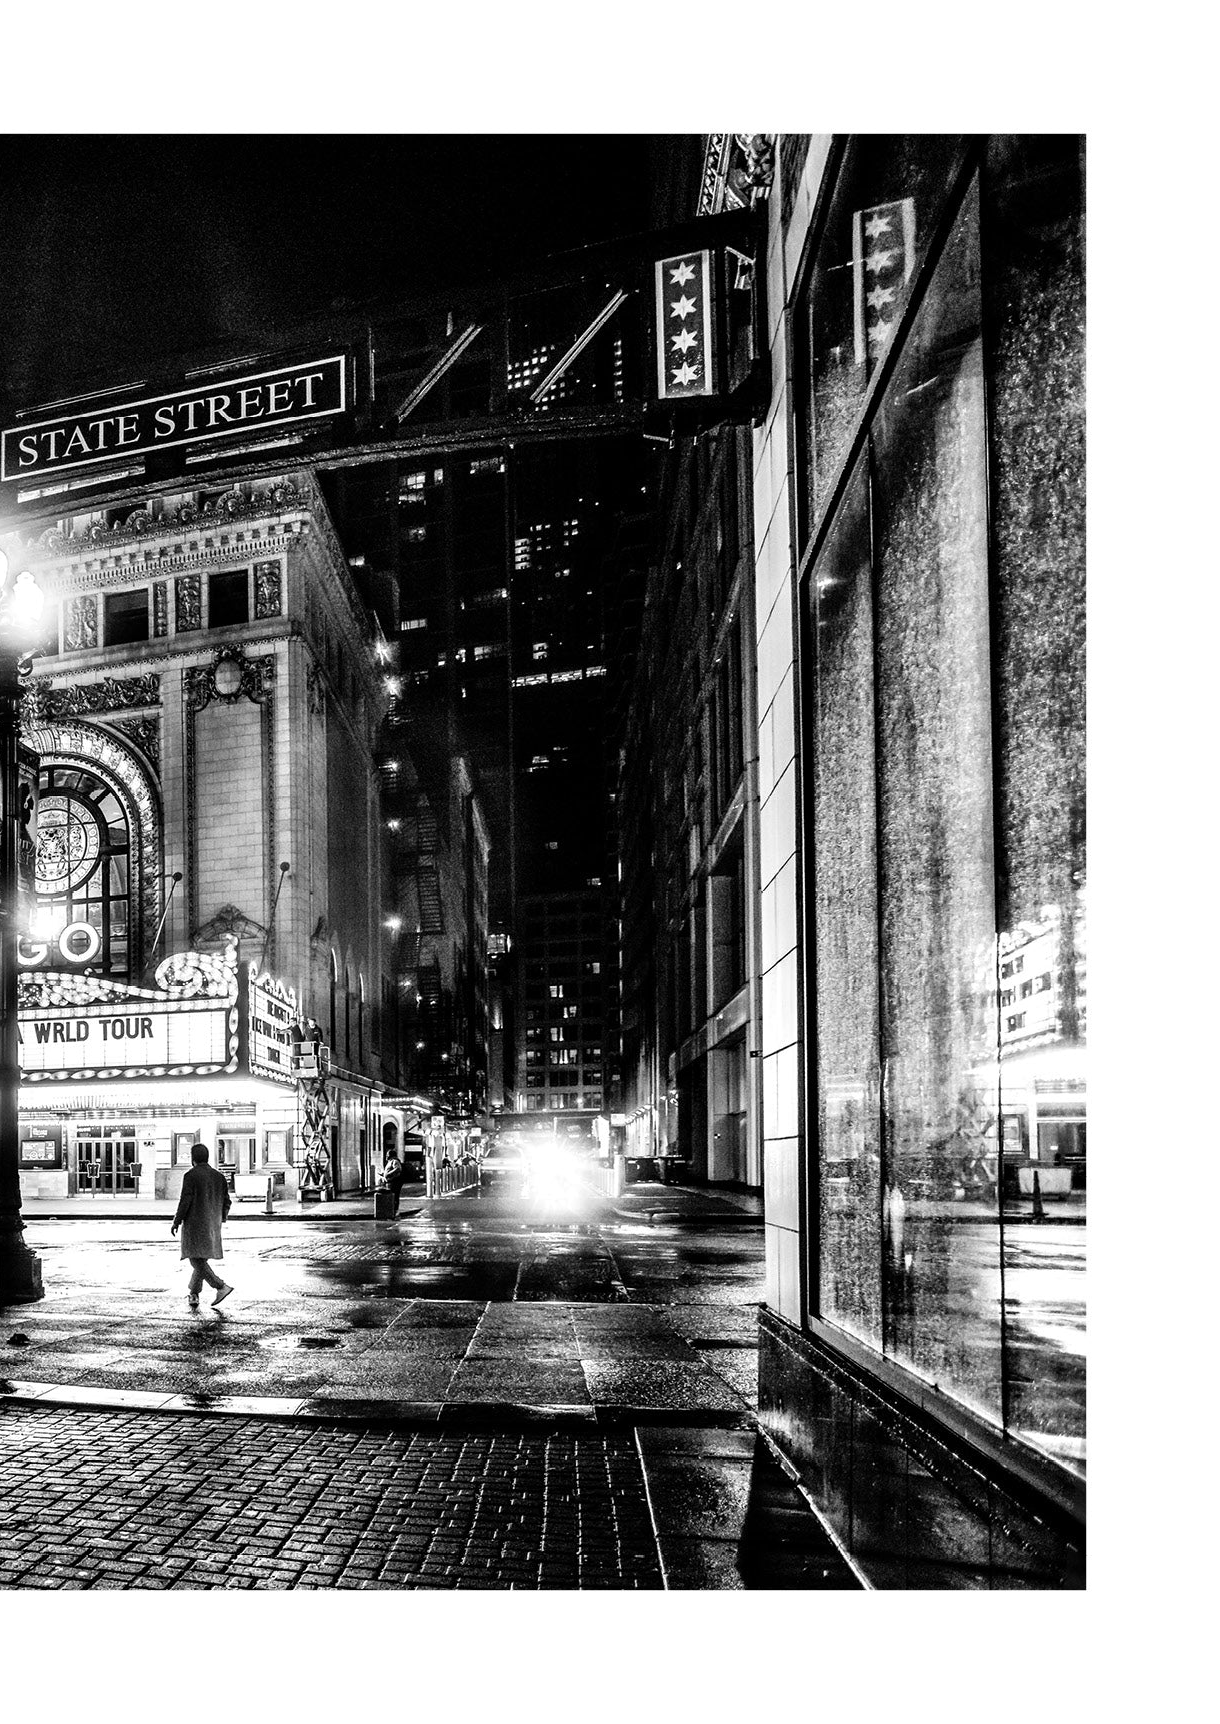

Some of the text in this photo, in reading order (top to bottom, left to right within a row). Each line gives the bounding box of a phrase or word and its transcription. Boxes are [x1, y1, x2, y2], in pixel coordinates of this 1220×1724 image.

[18, 373, 323, 467] STATE STREET
[34, 1021, 89, 1044] WRLD
[99, 1017, 154, 1041] TOUR
